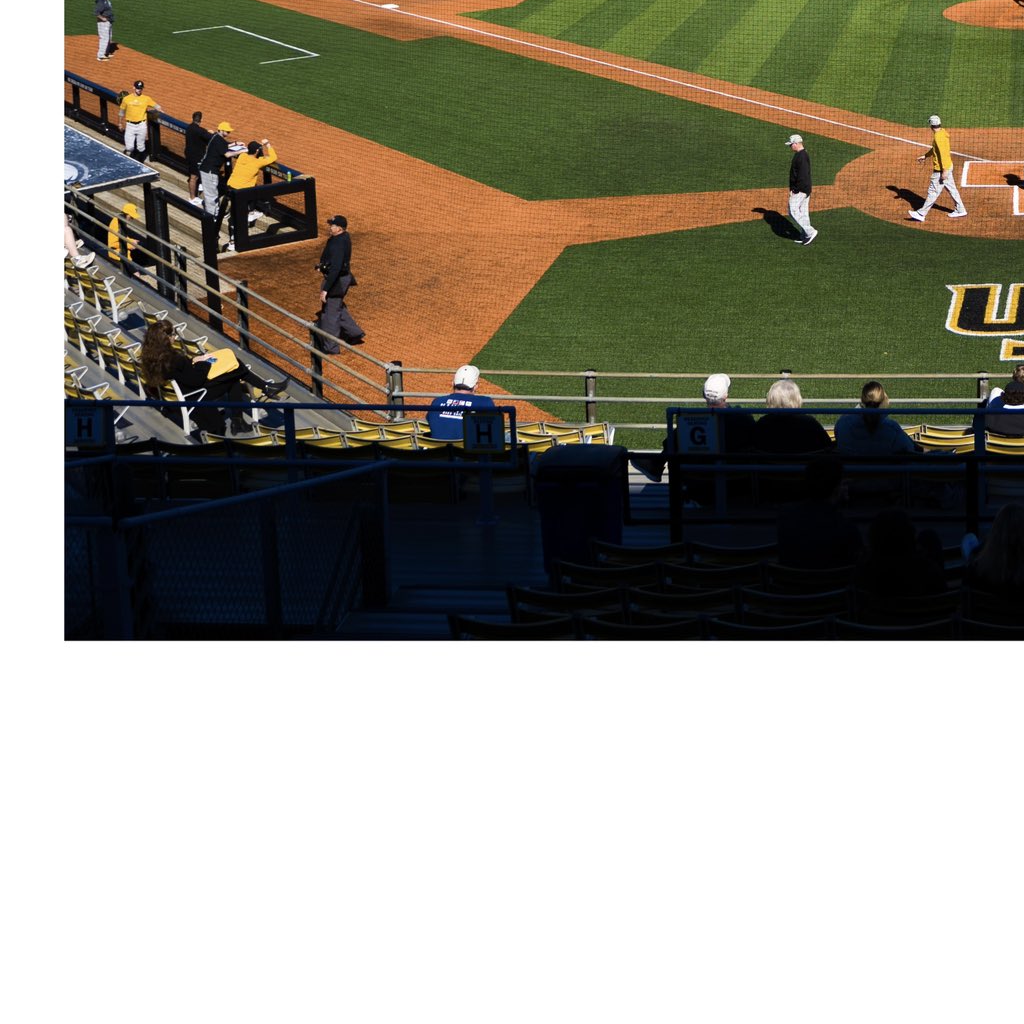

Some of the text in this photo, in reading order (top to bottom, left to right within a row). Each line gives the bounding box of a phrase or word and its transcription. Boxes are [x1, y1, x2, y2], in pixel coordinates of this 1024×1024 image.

[77, 418, 92, 437] H
[476, 423, 492, 443] H
[690, 426, 707, 445] G
